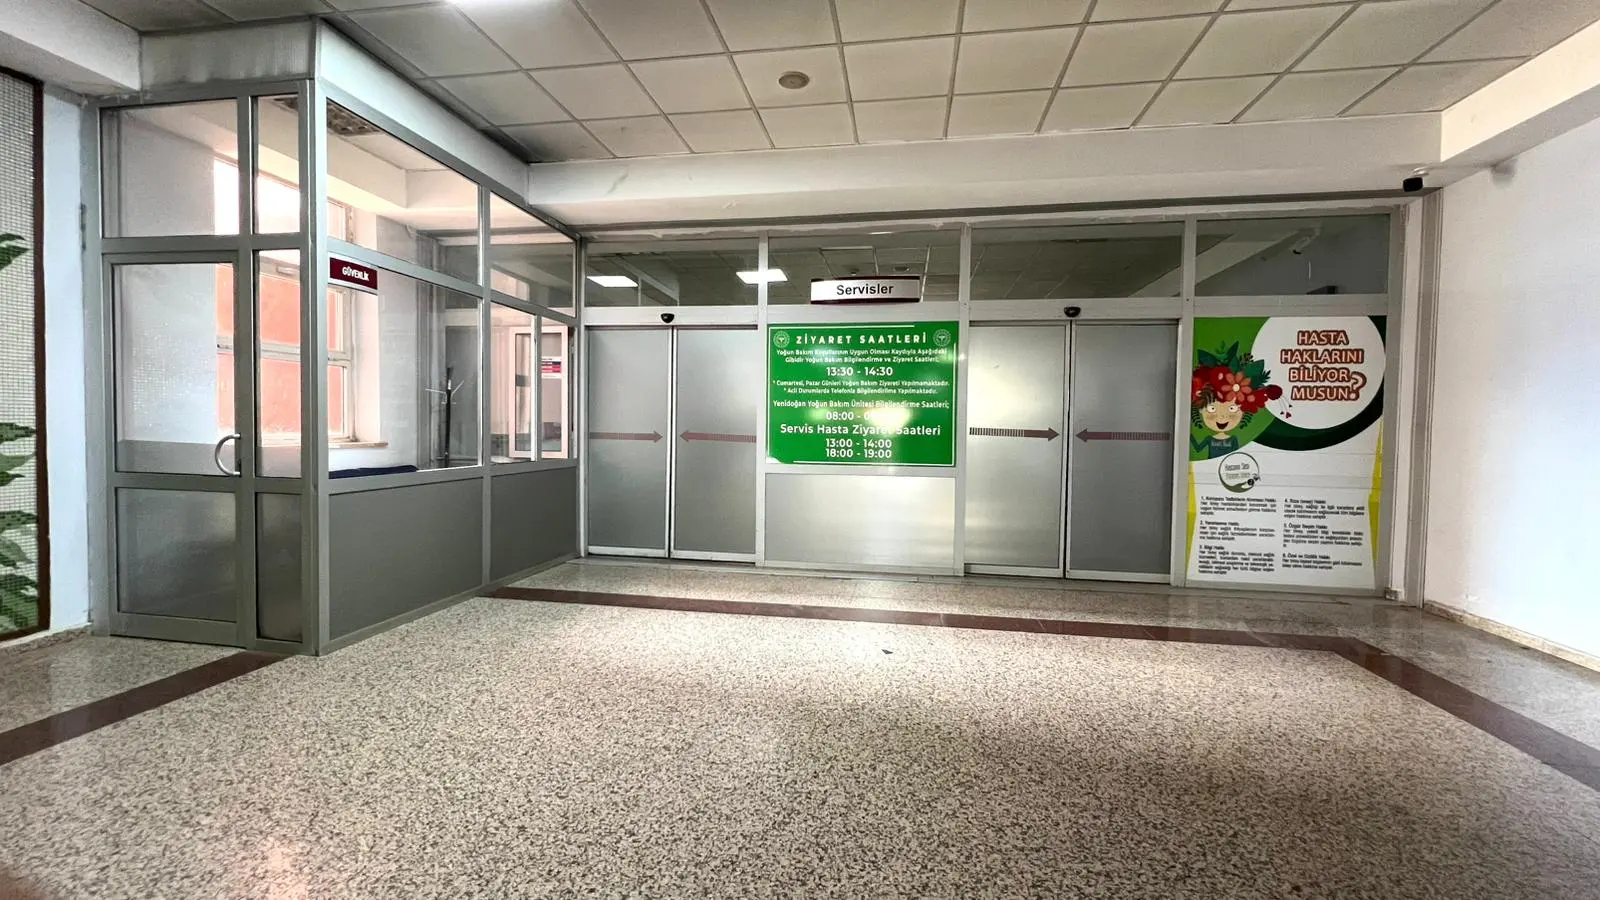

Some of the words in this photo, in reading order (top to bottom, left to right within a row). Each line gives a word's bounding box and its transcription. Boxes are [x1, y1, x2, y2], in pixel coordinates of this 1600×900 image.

[836, 283, 894, 296] Servisler
[796, 333, 852, 344] ZİYARET
[860, 332, 926, 344] SAATLERİ
[1297, 330, 1349, 345] HASTA
[1280, 349, 1364, 364] HAKLARINI
[826, 367, 854, 376] 13:30
[864, 366, 893, 376] 14:30
[1288, 365, 1350, 382] BİLİYOR
[1291, 371, 1367, 400] MUSUN?
[773, 400, 806, 408] Yenidoğan
[808, 400, 828, 408] Yoğun
[826, 411, 854, 421] 08:00
[780, 424, 814, 433] Servis
[817, 424, 848, 434] Hasta
[895, 425, 941, 435] Saatleri
[825, 438, 853, 448] 13:00
[863, 439, 892, 448] 14:00
[825, 448, 854, 458] 18:00
[863, 449, 892, 458] 19:00
